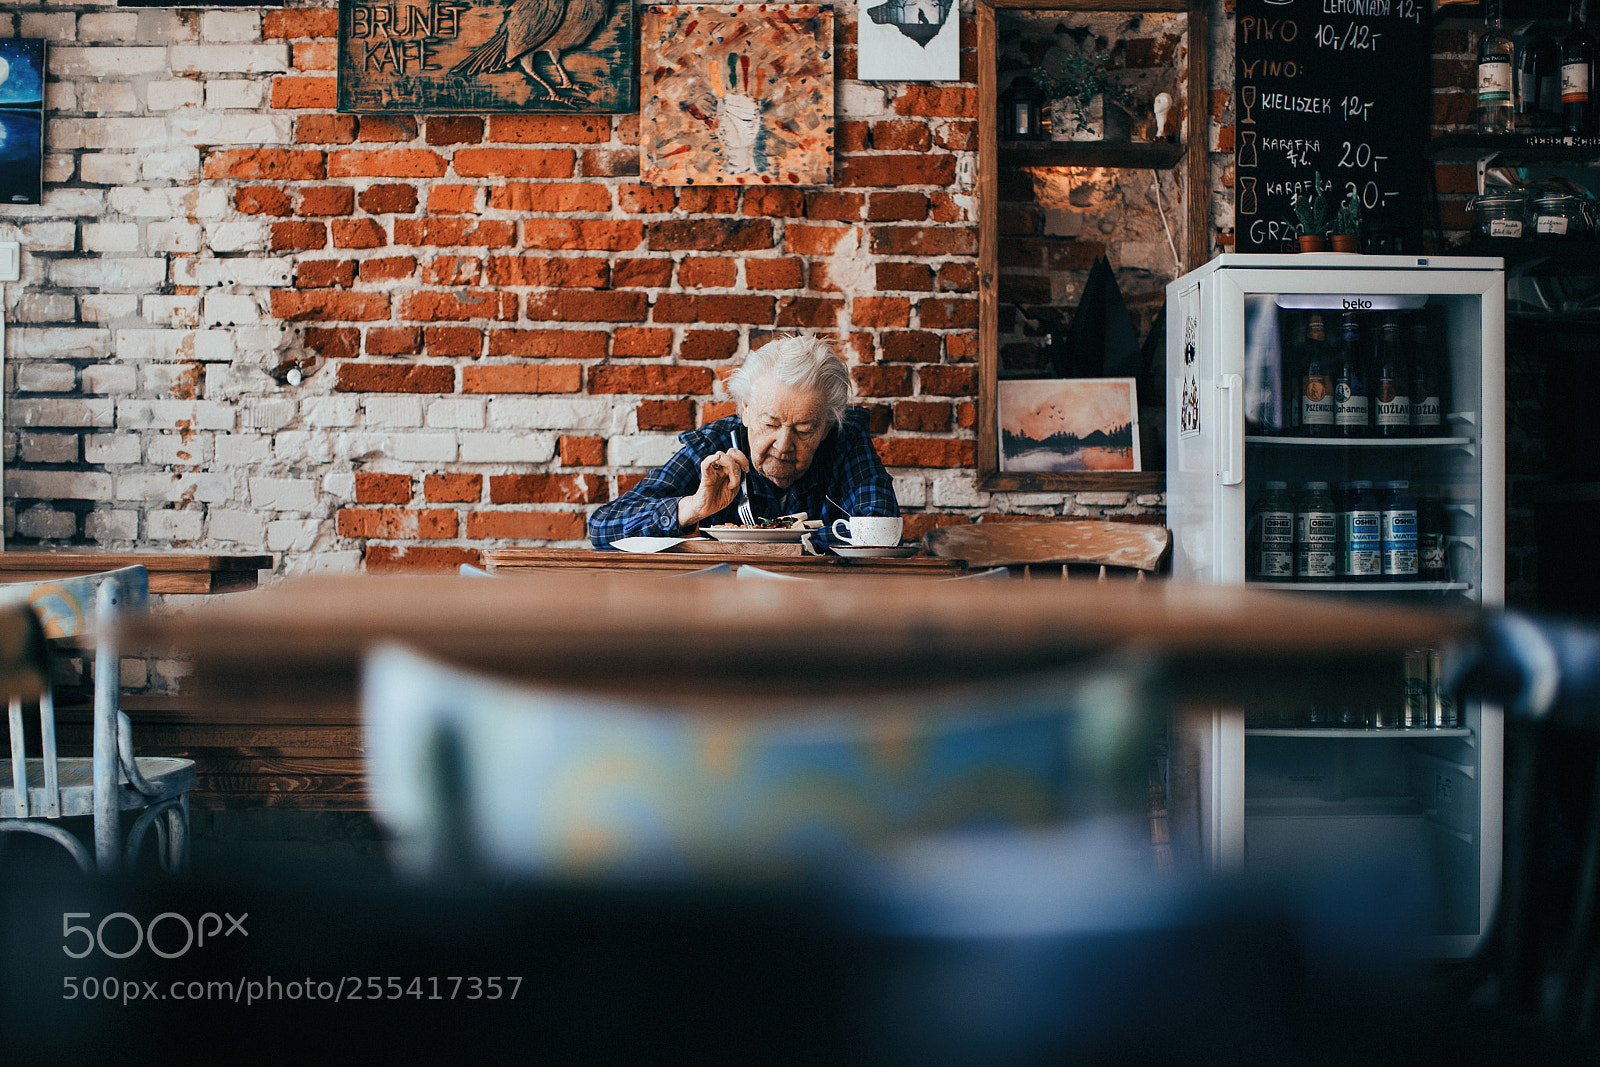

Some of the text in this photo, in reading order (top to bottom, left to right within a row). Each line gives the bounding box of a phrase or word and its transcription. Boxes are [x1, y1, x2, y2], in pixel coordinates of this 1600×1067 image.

[350, 2, 470, 39] BRUNET
[1240, 15, 1299, 44] PIWO
[362, 37, 442, 76] KAFE
[1241, 58, 1304, 80] WINO:
[1261, 93, 1331, 115] KIELISZEK
[1262, 137, 1321, 153] KARAFKA
[1342, 298, 1373, 310] beko
